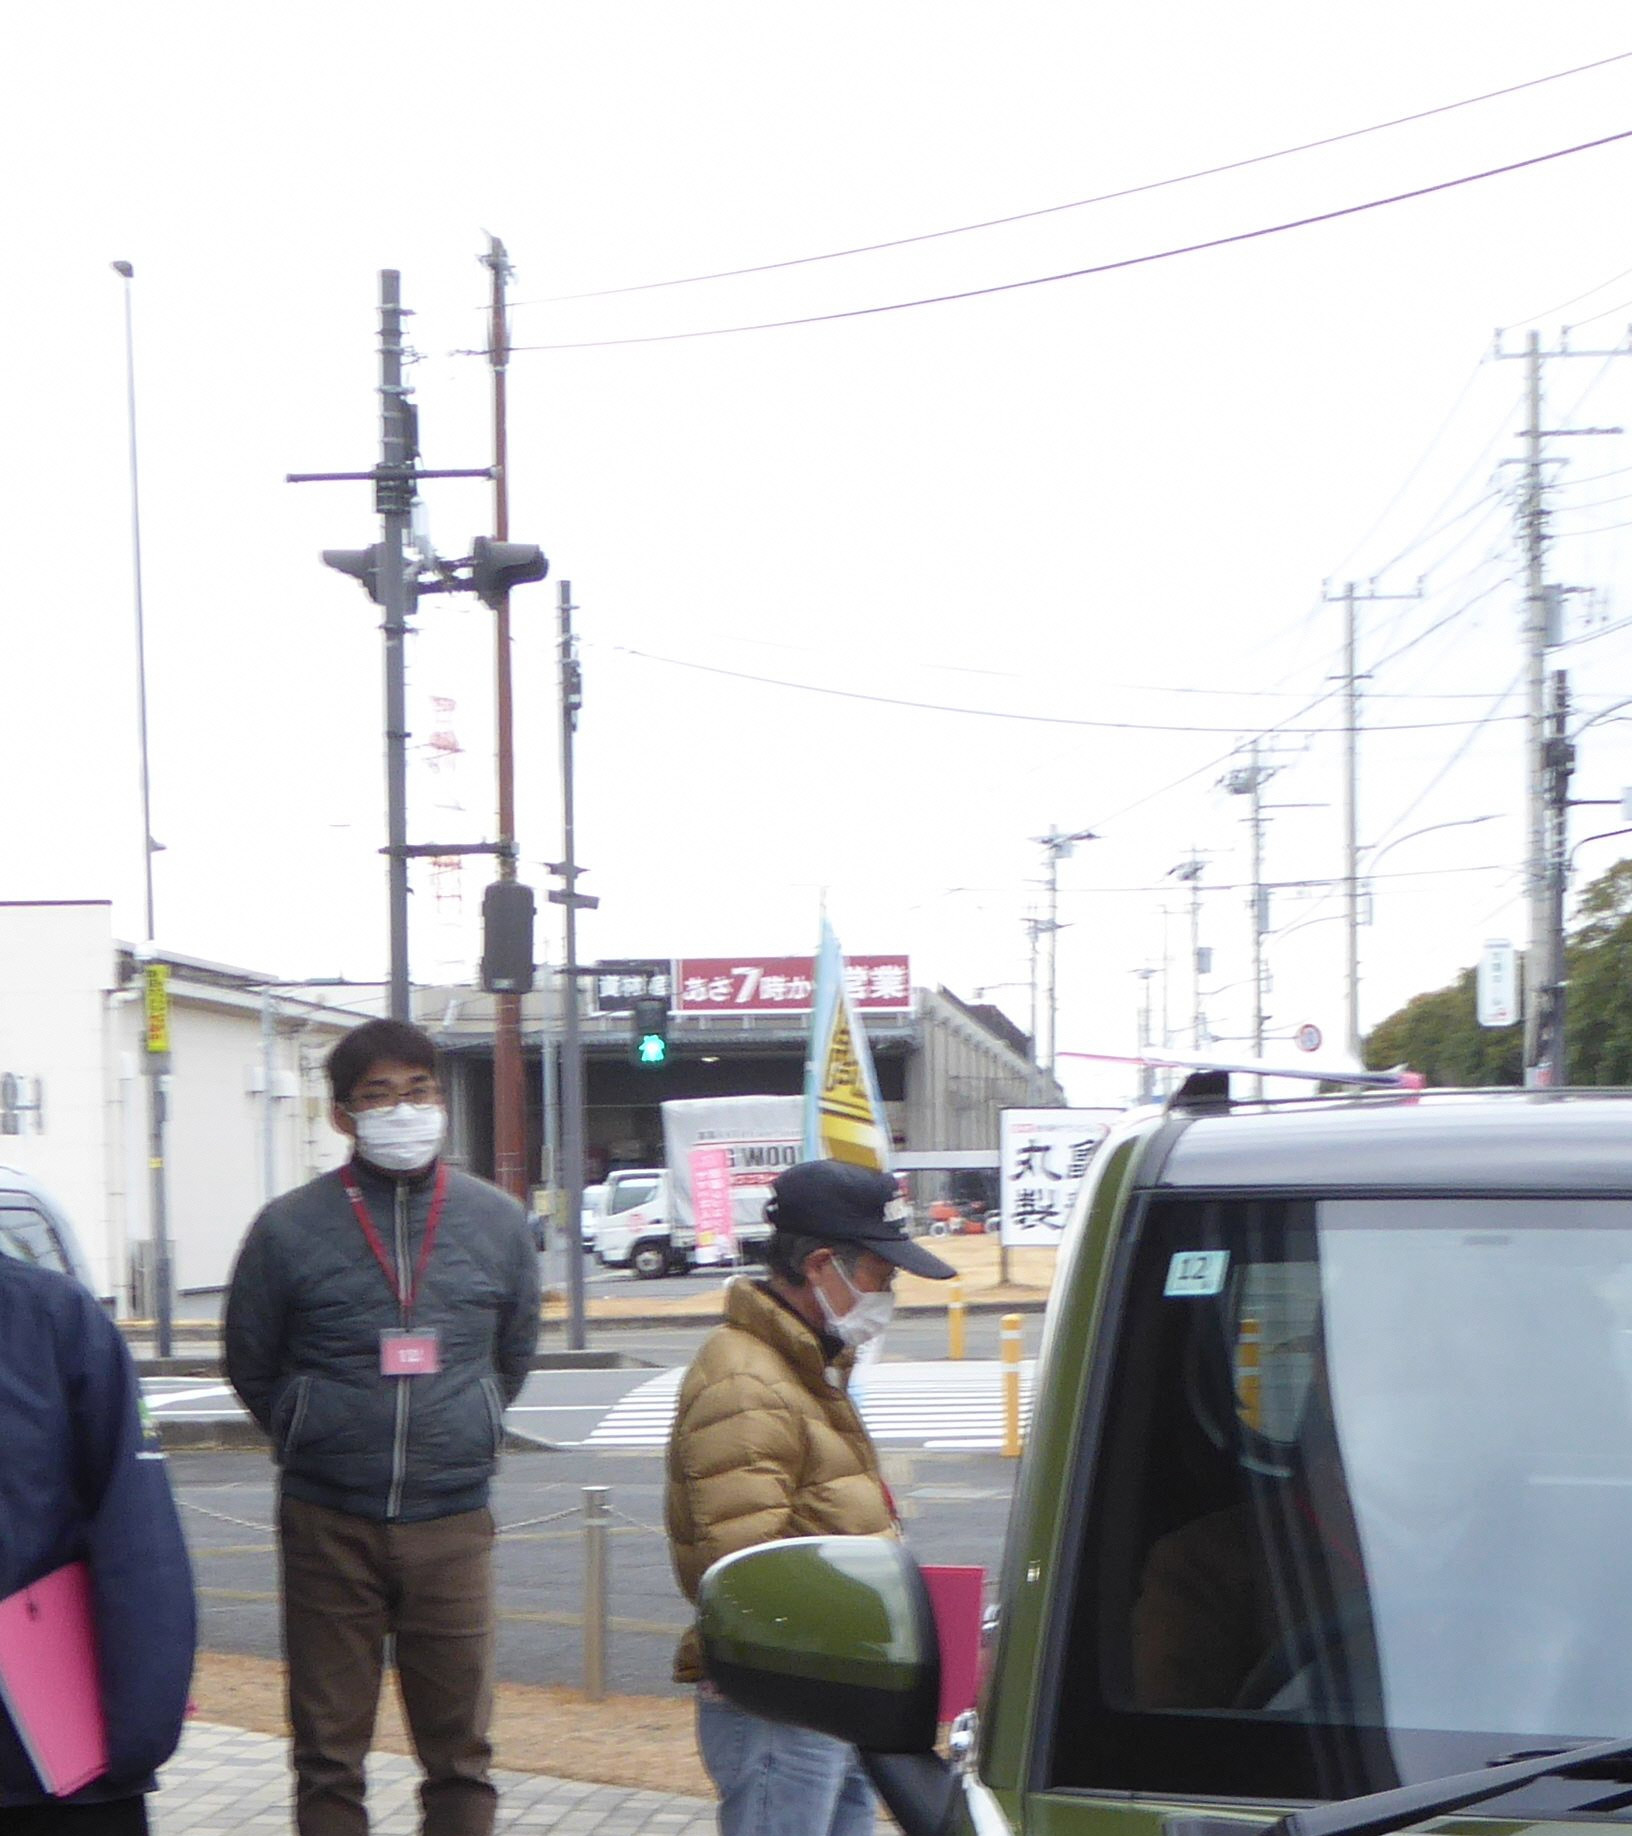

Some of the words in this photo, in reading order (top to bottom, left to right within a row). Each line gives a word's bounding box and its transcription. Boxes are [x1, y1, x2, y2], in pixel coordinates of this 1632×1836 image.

[683, 965, 907, 1003] あさ7時か営業
